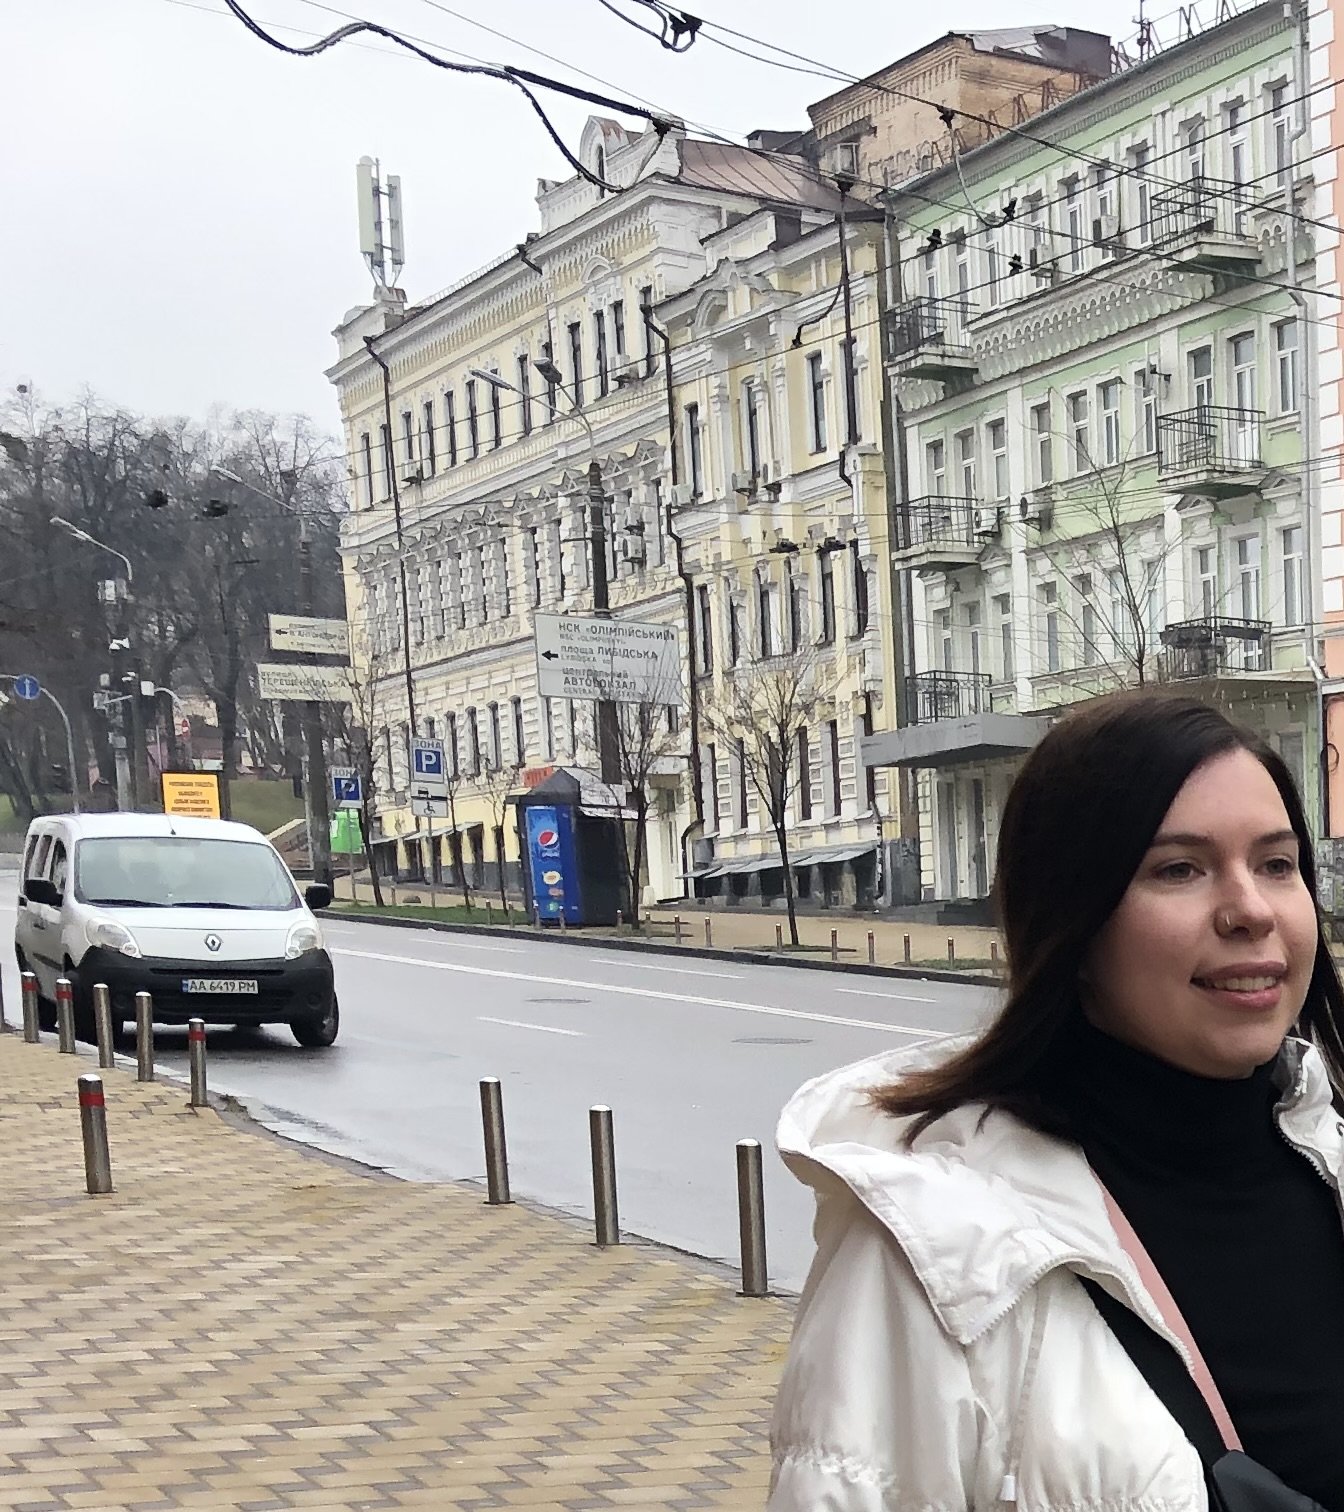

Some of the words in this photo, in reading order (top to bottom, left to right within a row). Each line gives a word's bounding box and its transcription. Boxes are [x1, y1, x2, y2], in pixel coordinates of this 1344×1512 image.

[558, 622, 580, 633] НСК
[415, 740, 441, 749] ЗОНА
[190, 980, 206, 991] AA
[209, 981, 236, 992] 6419
[238, 981, 255, 992] PM
